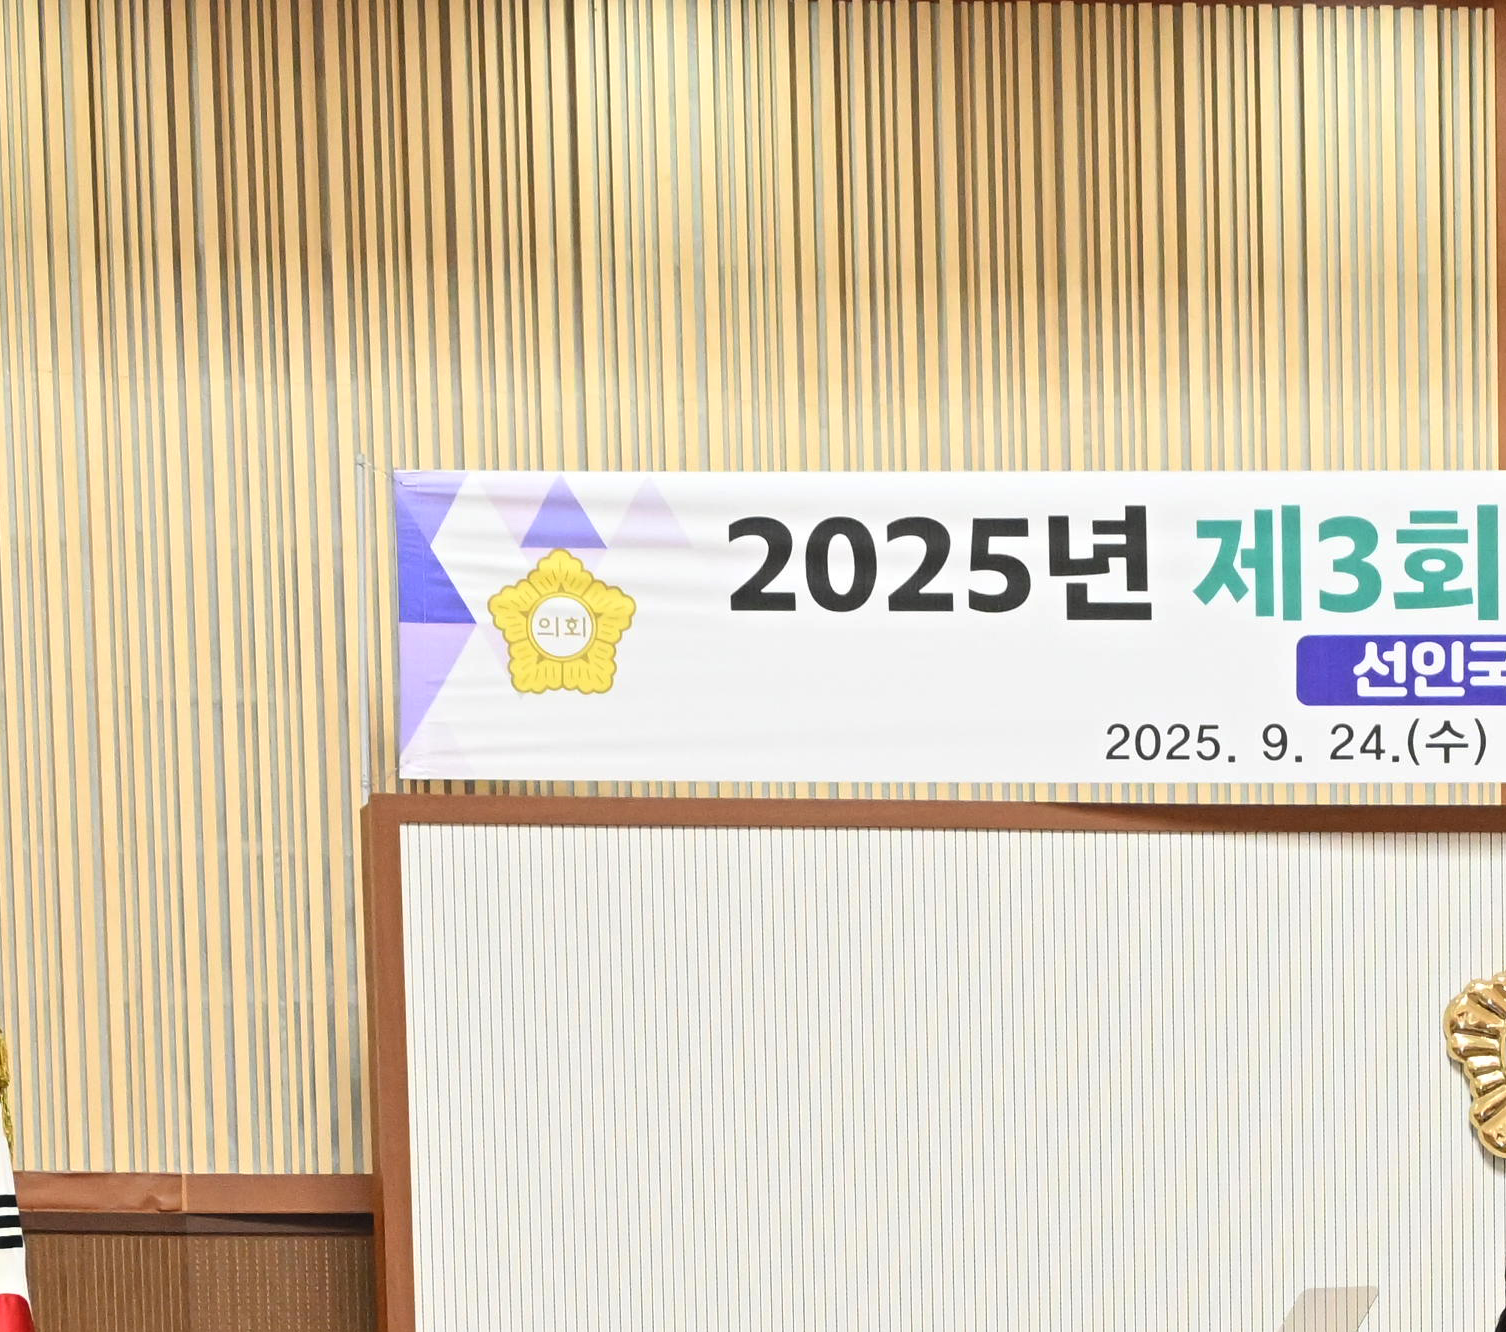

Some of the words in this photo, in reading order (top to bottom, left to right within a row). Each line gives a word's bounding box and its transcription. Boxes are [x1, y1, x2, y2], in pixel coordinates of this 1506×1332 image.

[728, 503, 1153, 622] 2025년
[1192, 502, 1499, 622] 제3회
[537, 616, 587, 638] 의회
[1105, 721, 1239, 764] 2025.
[1260, 721, 1305, 764] 9.
[1328, 716, 1489, 768] 24.(수)
